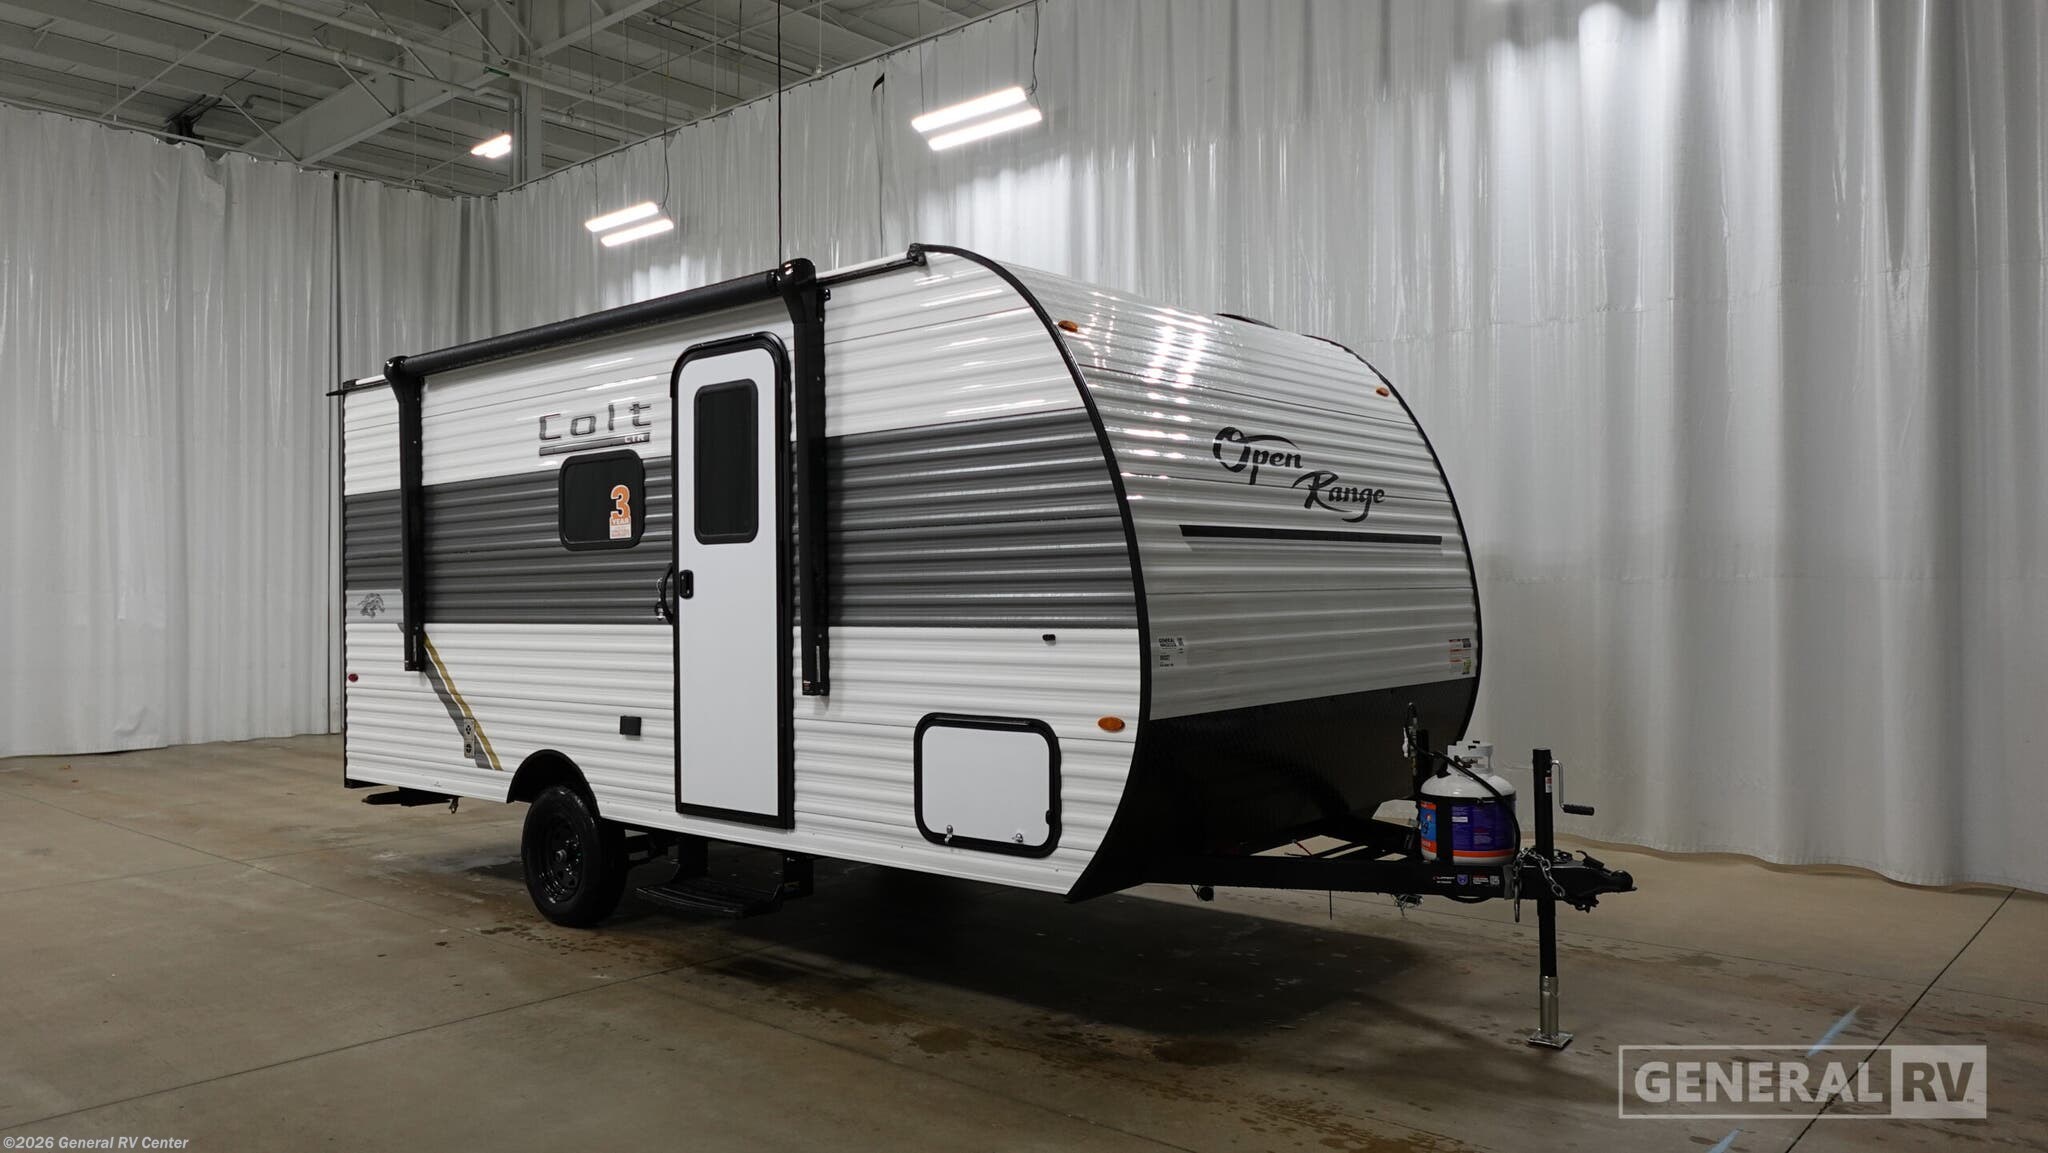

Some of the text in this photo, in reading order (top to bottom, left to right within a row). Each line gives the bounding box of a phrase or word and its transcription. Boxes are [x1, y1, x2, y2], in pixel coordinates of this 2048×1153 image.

[539, 402, 651, 440] Colt
[1212, 427, 1303, 485] Open
[610, 484, 631, 518] 3
[1292, 471, 1385, 523] Range
